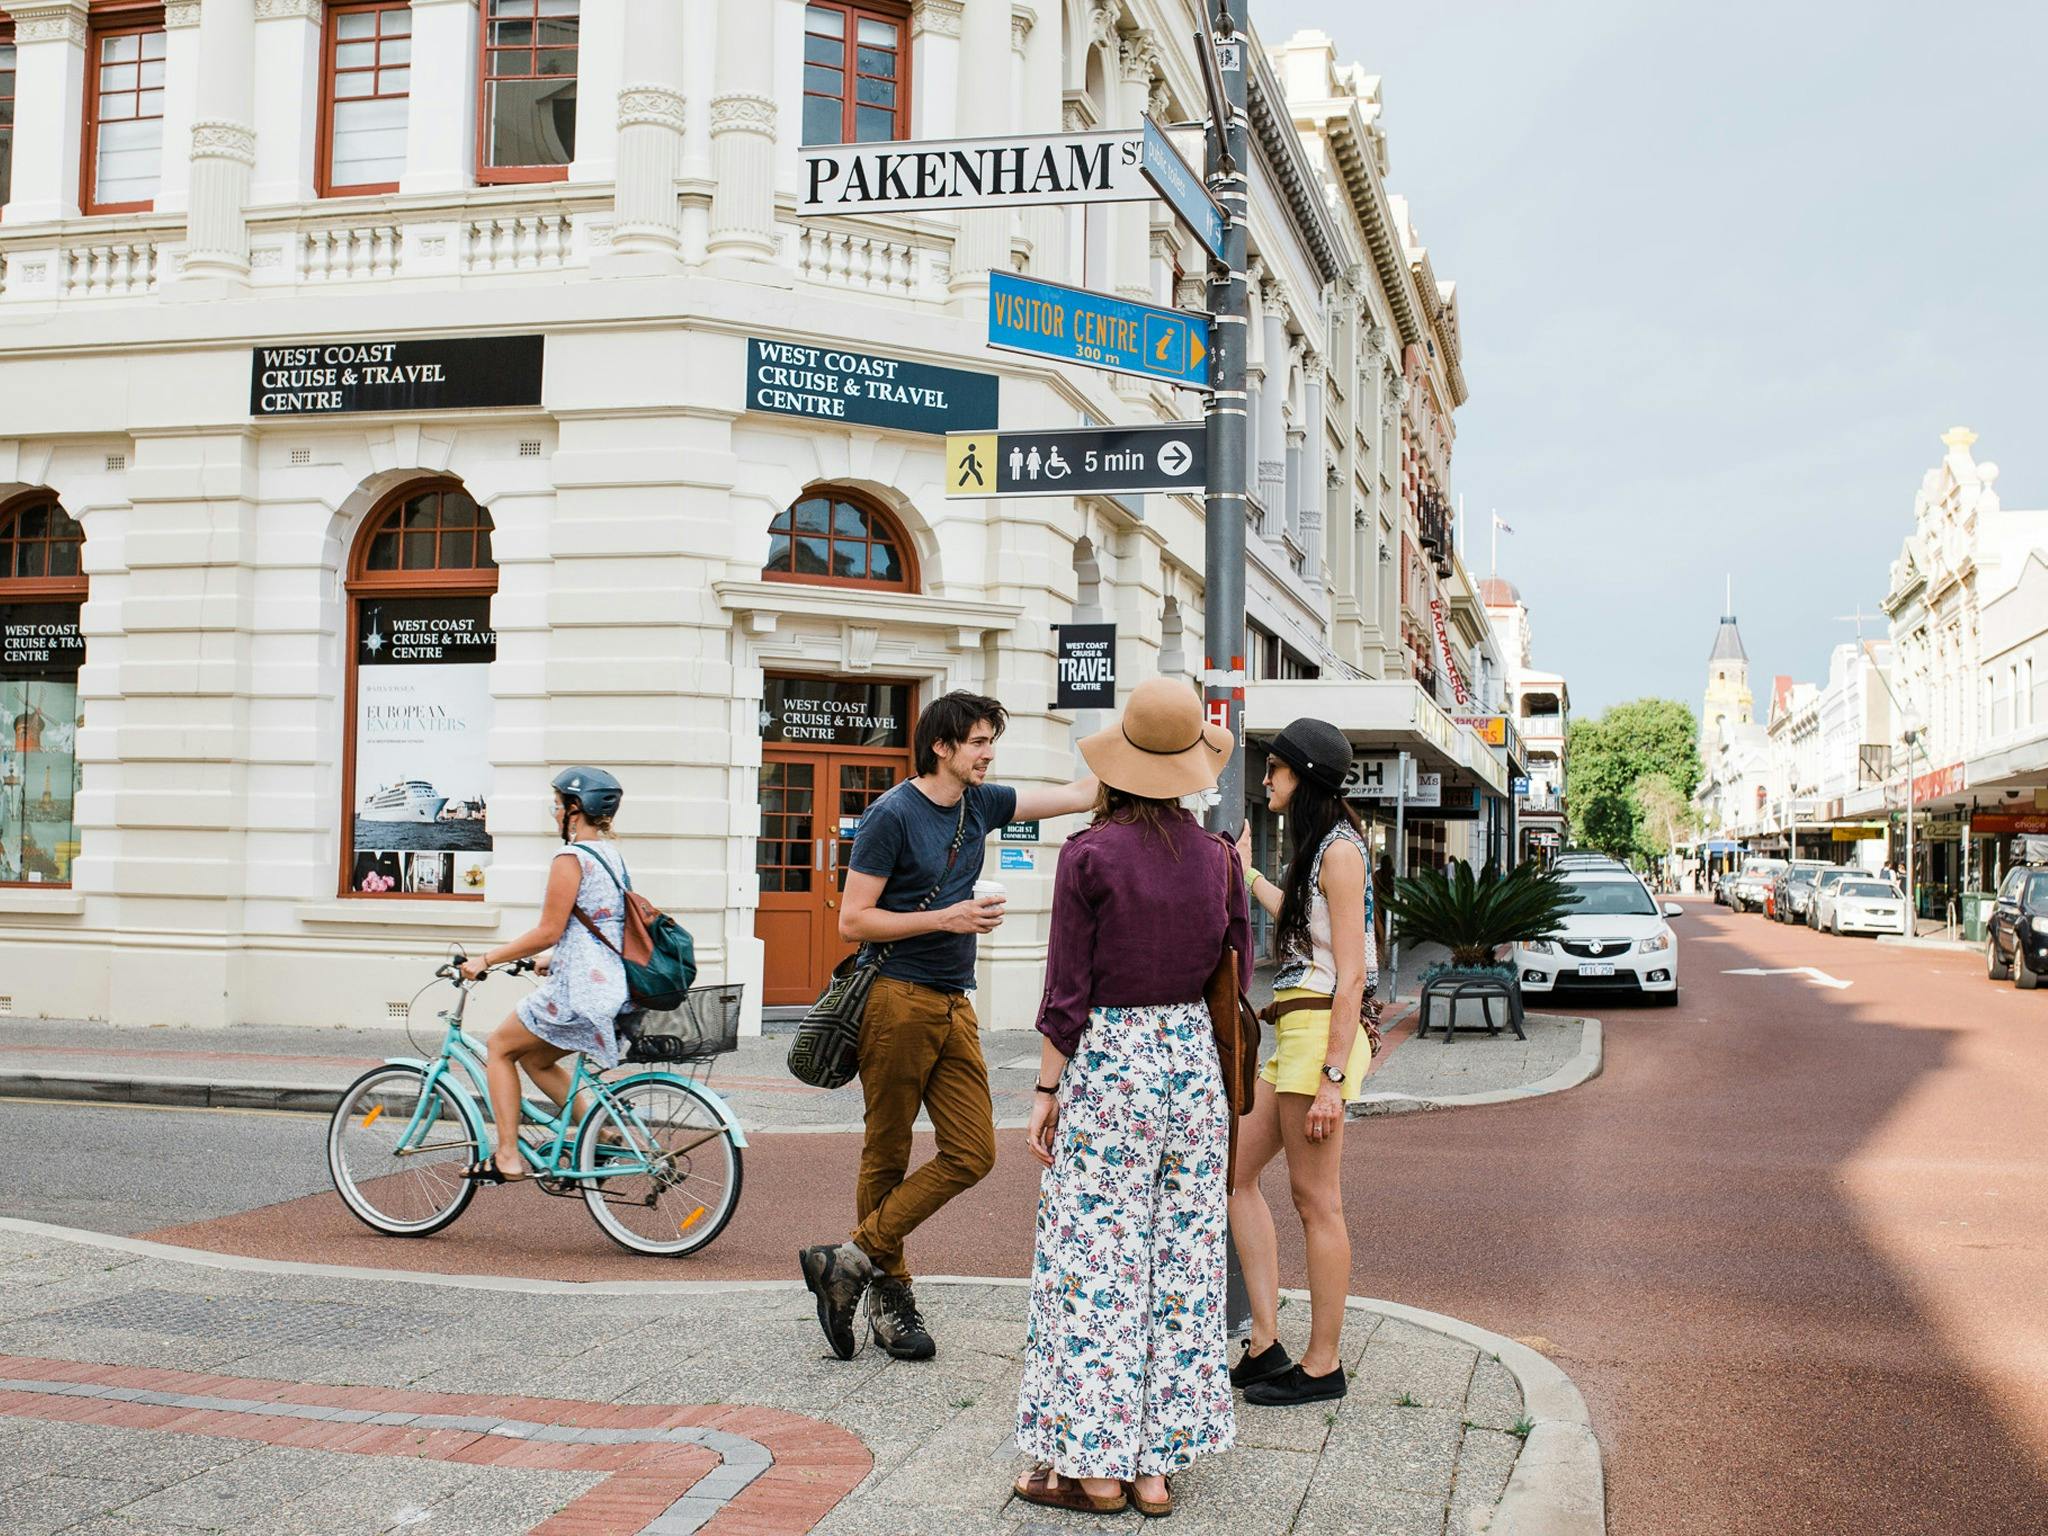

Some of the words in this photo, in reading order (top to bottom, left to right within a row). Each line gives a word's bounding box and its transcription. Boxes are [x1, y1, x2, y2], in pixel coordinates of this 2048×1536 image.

[804, 143, 1114, 204] PAKENHAM
[1149, 142, 1167, 175] public
[1167, 163, 1186, 198] toilets
[995, 292, 1064, 338] VISITOR
[1074, 309, 1138, 354] CENTRE
[262, 348, 321, 368] WEST
[324, 344, 396, 365] COAST
[758, 342, 820, 368] WEST
[824, 352, 898, 379] COAST
[1075, 344, 1101, 361] 300
[1105, 352, 1120, 365] m
[262, 368, 337, 388] CRUISE
[341, 368, 358, 386] &
[362, 364, 446, 385] TRAVEL
[758, 365, 838, 393] CRUISE
[843, 378, 861, 396] &
[865, 380, 948, 409] TRAVEL
[261, 391, 343, 412] CENTRE
[757, 388, 845, 417] CENTRE
[1084, 450, 1098, 472] 5
[1104, 449, 1144, 472] min
[4, 625, 37, 636] WEST
[38, 624, 78, 635] COAST
[392, 620, 428, 631] WEST
[430, 619, 475, 631] COAST
[4, 637, 46, 649] CRUISE
[47, 637, 58, 648] &
[392, 633, 439, 645] CRUISE
[441, 633, 452, 645] &
[4, 650, 50, 662] CENTRE
[392, 647, 443, 658] CENTRE
[1430, 599, 1468, 705] BACKPACKERS
[1059, 658, 1115, 682] TRAVEL
[1071, 683, 1102, 691] CENTRE
[367, 705, 446, 718] EUROPEAN
[783, 698, 820, 712] WEST
[822, 701, 867, 714] COAST
[1207, 703, 1227, 728] H
[783, 712, 831, 726] CRUISE
[833, 715, 844, 726] &
[847, 715, 897, 729] TRAVEL
[782, 726, 835, 740] CENTRE
[1007, 825, 1024, 833] HIGH
